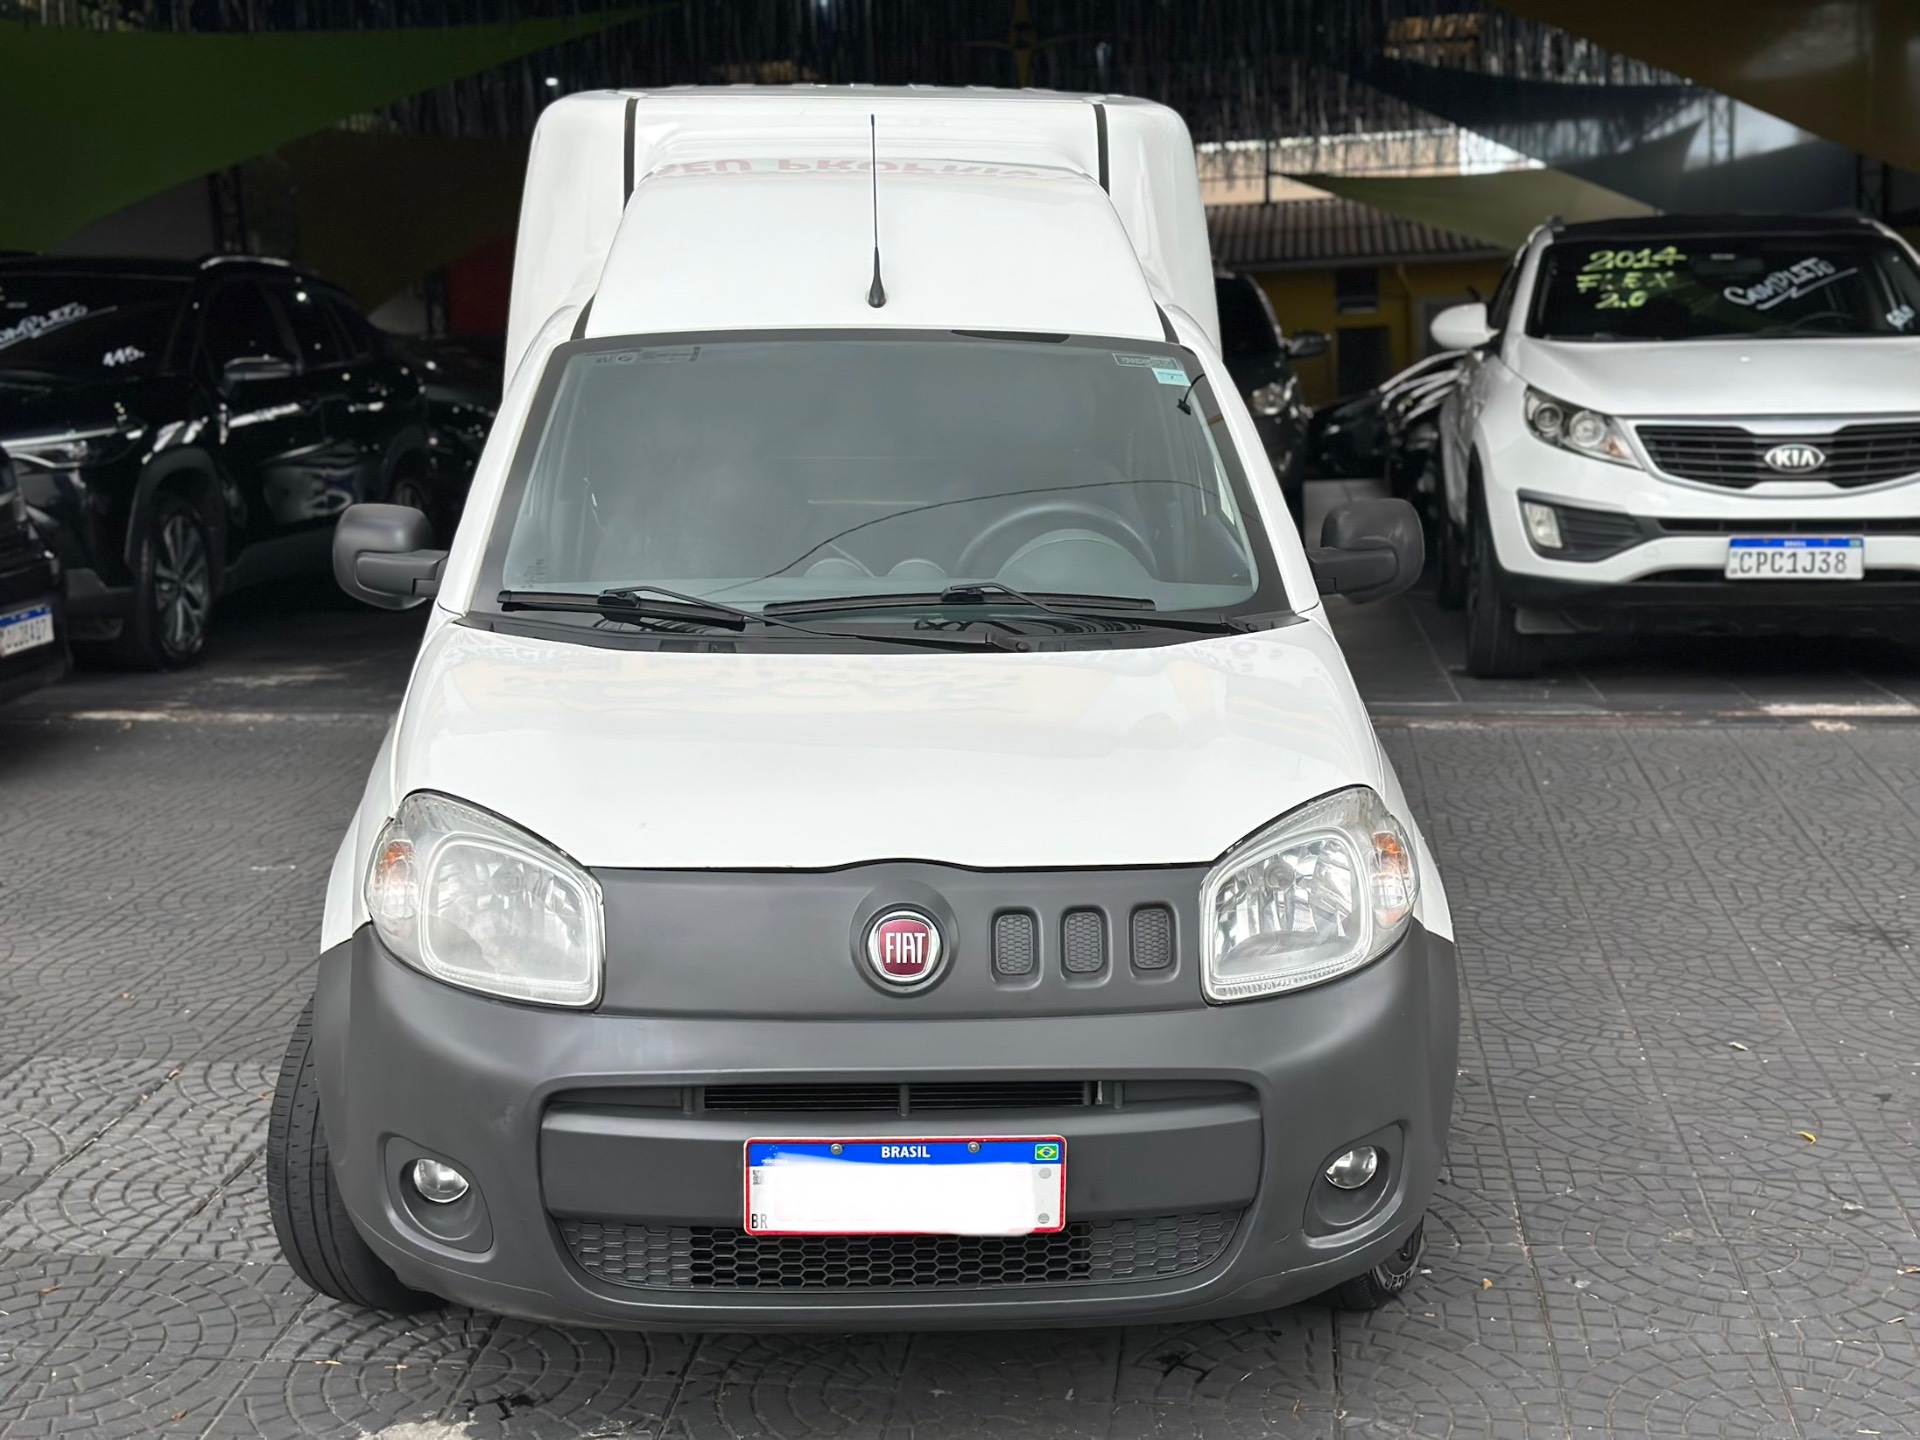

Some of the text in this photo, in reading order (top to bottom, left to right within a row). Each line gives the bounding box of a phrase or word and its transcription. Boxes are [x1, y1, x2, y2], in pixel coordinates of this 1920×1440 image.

[1582, 246, 1688, 272] 2014
[1594, 289, 1648, 309] 2.0
[1775, 448, 1816, 467] KIA
[1738, 551, 1847, 574] CPC1J38
[885, 932, 926, 964] FIAT
[881, 1145, 931, 1158] BRASIL
[751, 1213, 768, 1229] BR
